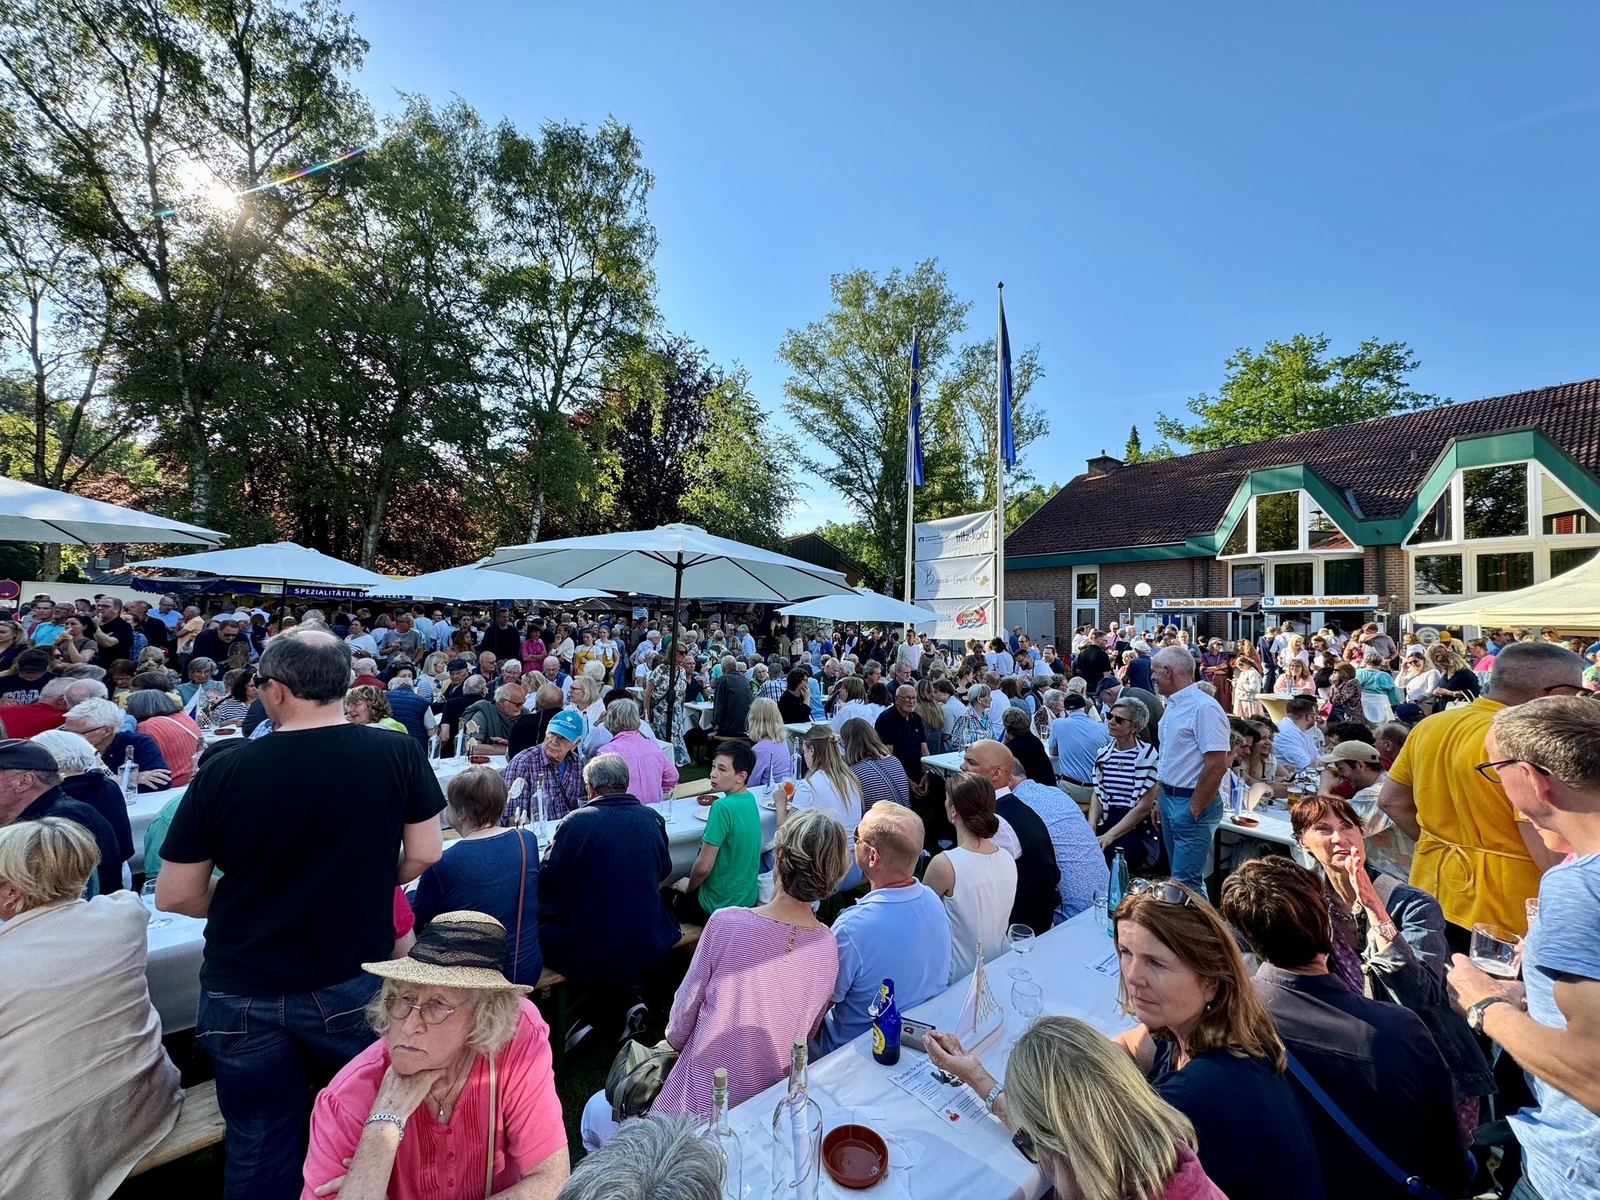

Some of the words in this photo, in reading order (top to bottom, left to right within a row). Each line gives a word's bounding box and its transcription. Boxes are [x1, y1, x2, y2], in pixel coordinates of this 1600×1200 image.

[955, 528, 989, 542] fritz-kola
[294, 588, 356, 597] SPEZIALITÄTEN
[1319, 597, 1370, 606] Großhansdorf
